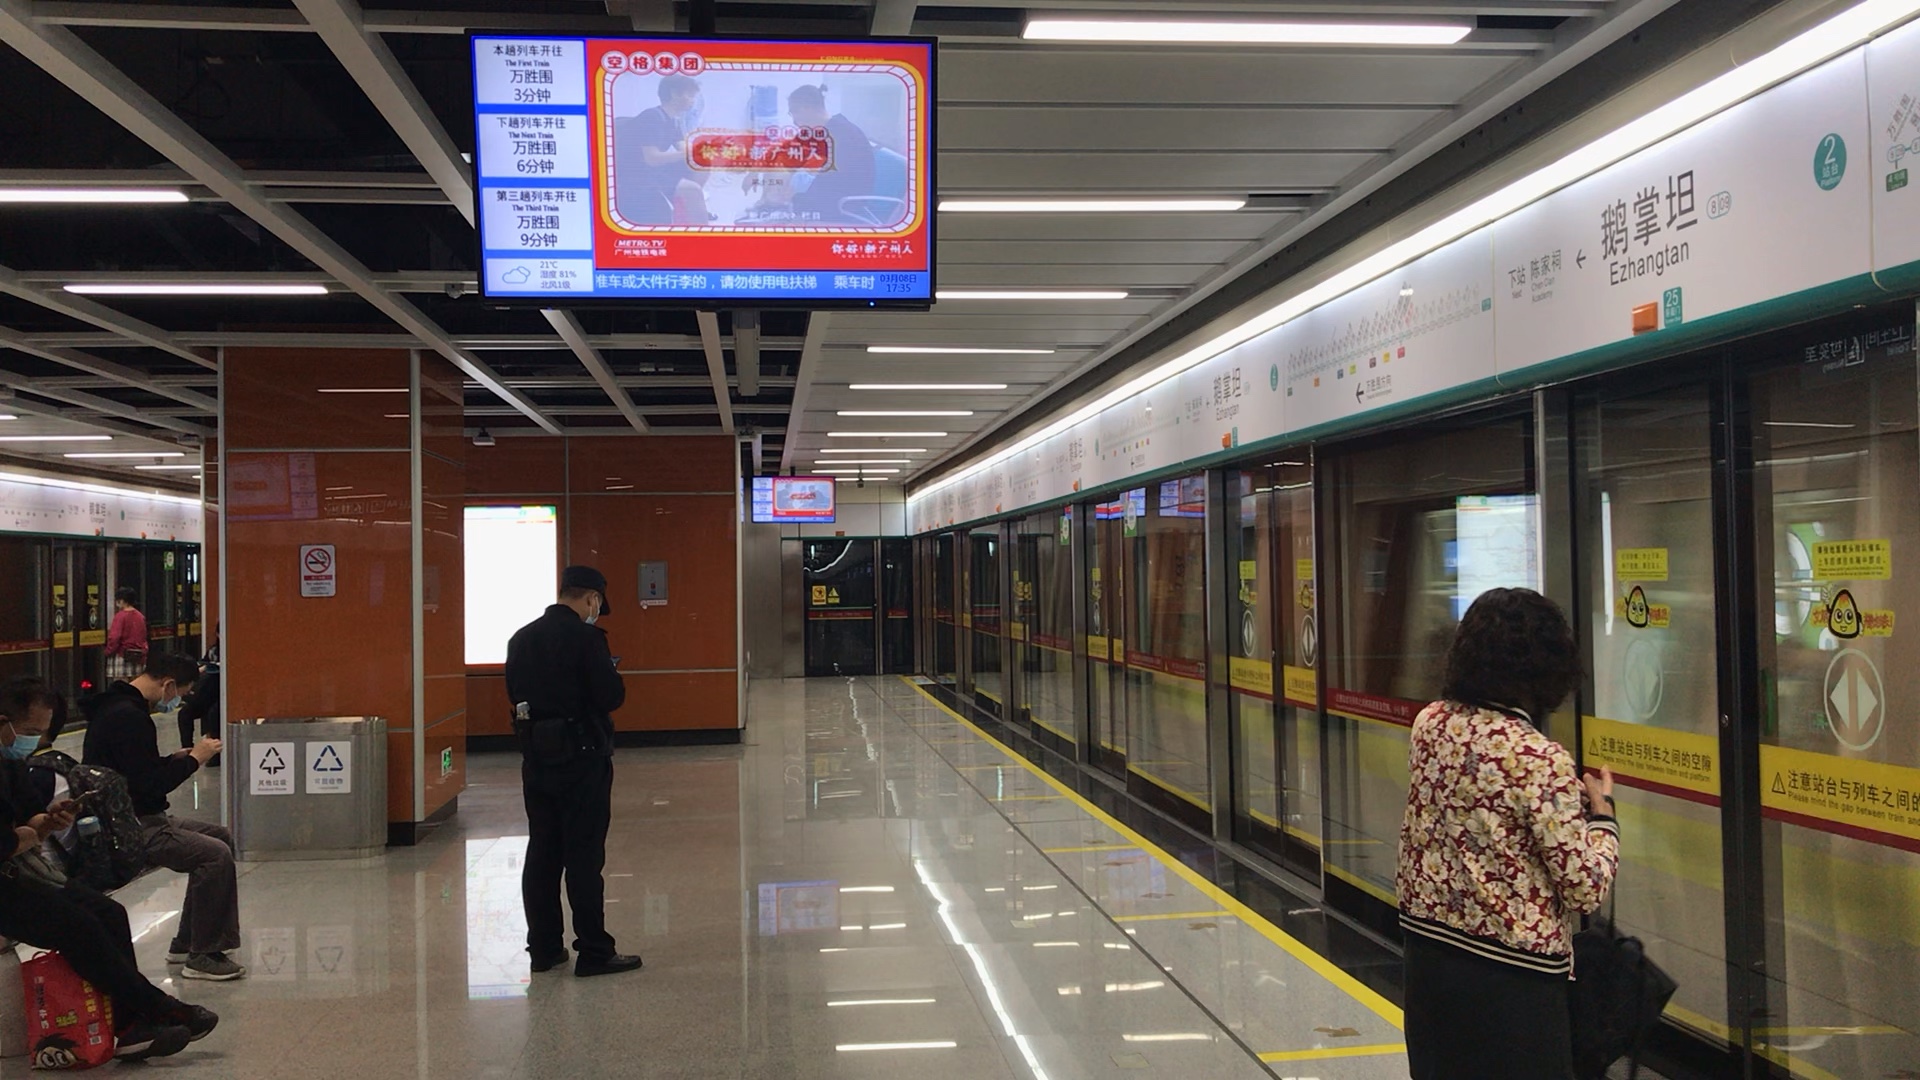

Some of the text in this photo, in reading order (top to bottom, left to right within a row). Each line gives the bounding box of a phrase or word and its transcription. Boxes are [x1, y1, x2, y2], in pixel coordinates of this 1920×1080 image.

[493, 44, 563, 57] 本趟列车开往
[606, 55, 700, 70] 空格集团
[509, 69, 553, 84] 万胜围
[514, 88, 551, 103] 3分钟
[496, 117, 566, 129] 下趟列车开往
[512, 140, 557, 155] 万胜围
[1824, 135, 1837, 165] 2
[516, 159, 554, 174] 6分钟
[496, 190, 577, 202] 第三趟列车开往
[517, 215, 560, 229] 万胜围
[1601, 170, 1698, 261] 鹅掌坦
[520, 233, 558, 248] 9分钟
[1508, 249, 1561, 288] 下站 陈家祠
[1610, 241, 1690, 286] Ezhangtan
[540, 270, 577, 279] 湿度 81%
[879, 274, 917, 283] 03月08日
[540, 280, 572, 289] 北风1级
[834, 275, 875, 290] 乘车时
[886, 284, 912, 293] 17:35
[1666, 289, 1679, 307] 25
[1600, 735, 1711, 772] 注意站台与列车之间的空隙
[1828, 798, 1839, 810] the
[1841, 802, 1854, 814] gap
[1856, 803, 1886, 820] between
